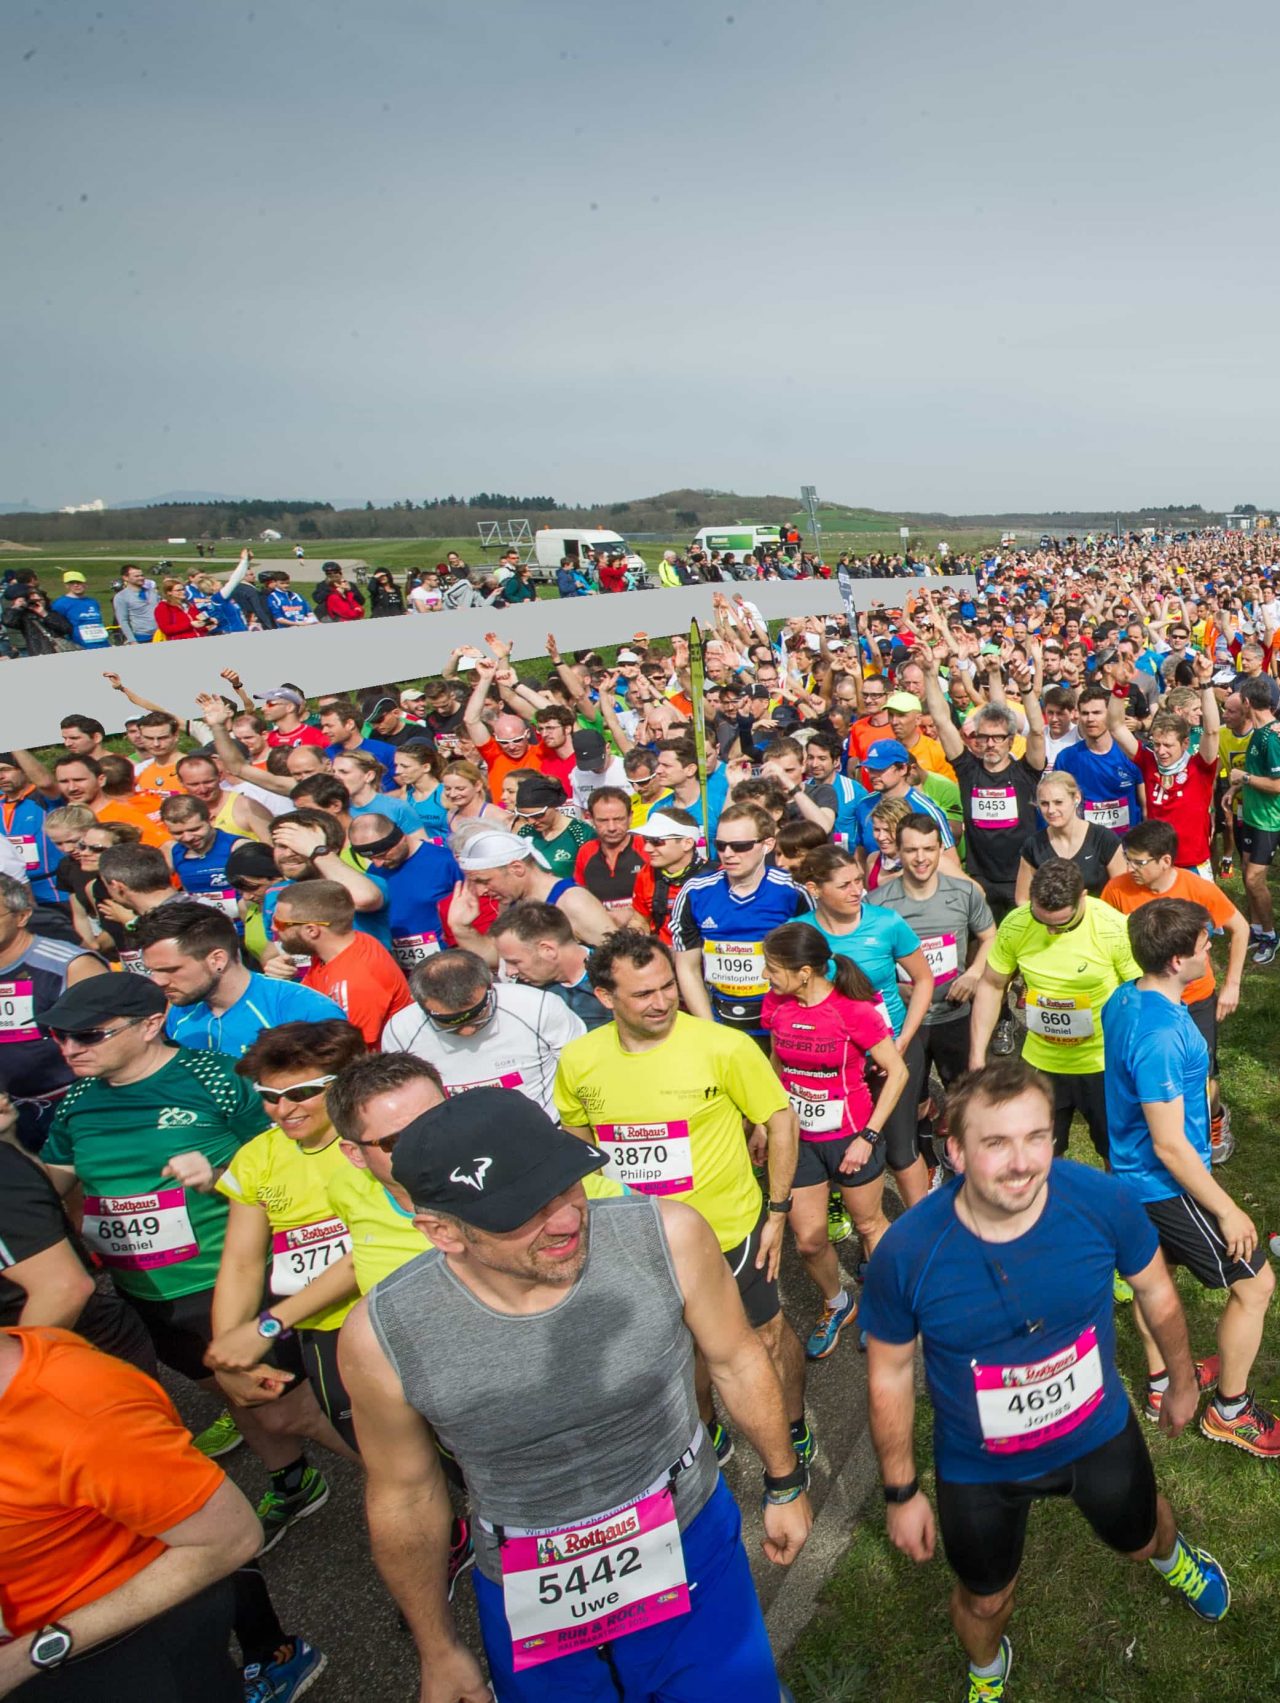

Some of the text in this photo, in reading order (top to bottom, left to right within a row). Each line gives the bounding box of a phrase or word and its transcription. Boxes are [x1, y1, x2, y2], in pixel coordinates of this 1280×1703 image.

[978, 800, 1006, 811] 6453
[1093, 810, 1120, 821] 7716
[716, 957, 753, 973] 1096
[1041, 1011, 1071, 1025] 660
[626, 1126, 667, 1138] Rothaus
[614, 1145, 668, 1166] 3870
[620, 1169, 662, 1181] Philipp
[111, 1197, 157, 1213] Rothaus
[99, 1216, 160, 1240] 6849
[300, 1222, 345, 1242] Rothaus
[110, 1239, 154, 1253] Daniel
[291, 1240, 347, 1274] 3771
[1008, 1374, 1076, 1415] 4691
[1024, 1401, 1071, 1428] Jonas
[564, 1515, 637, 1553] Rothaus
[539, 1546, 642, 1605] 5442
[570, 1591, 620, 1618] Uwe
[557, 1626, 588, 1643] RUN
[607, 1601, 648, 1625] ROCK
